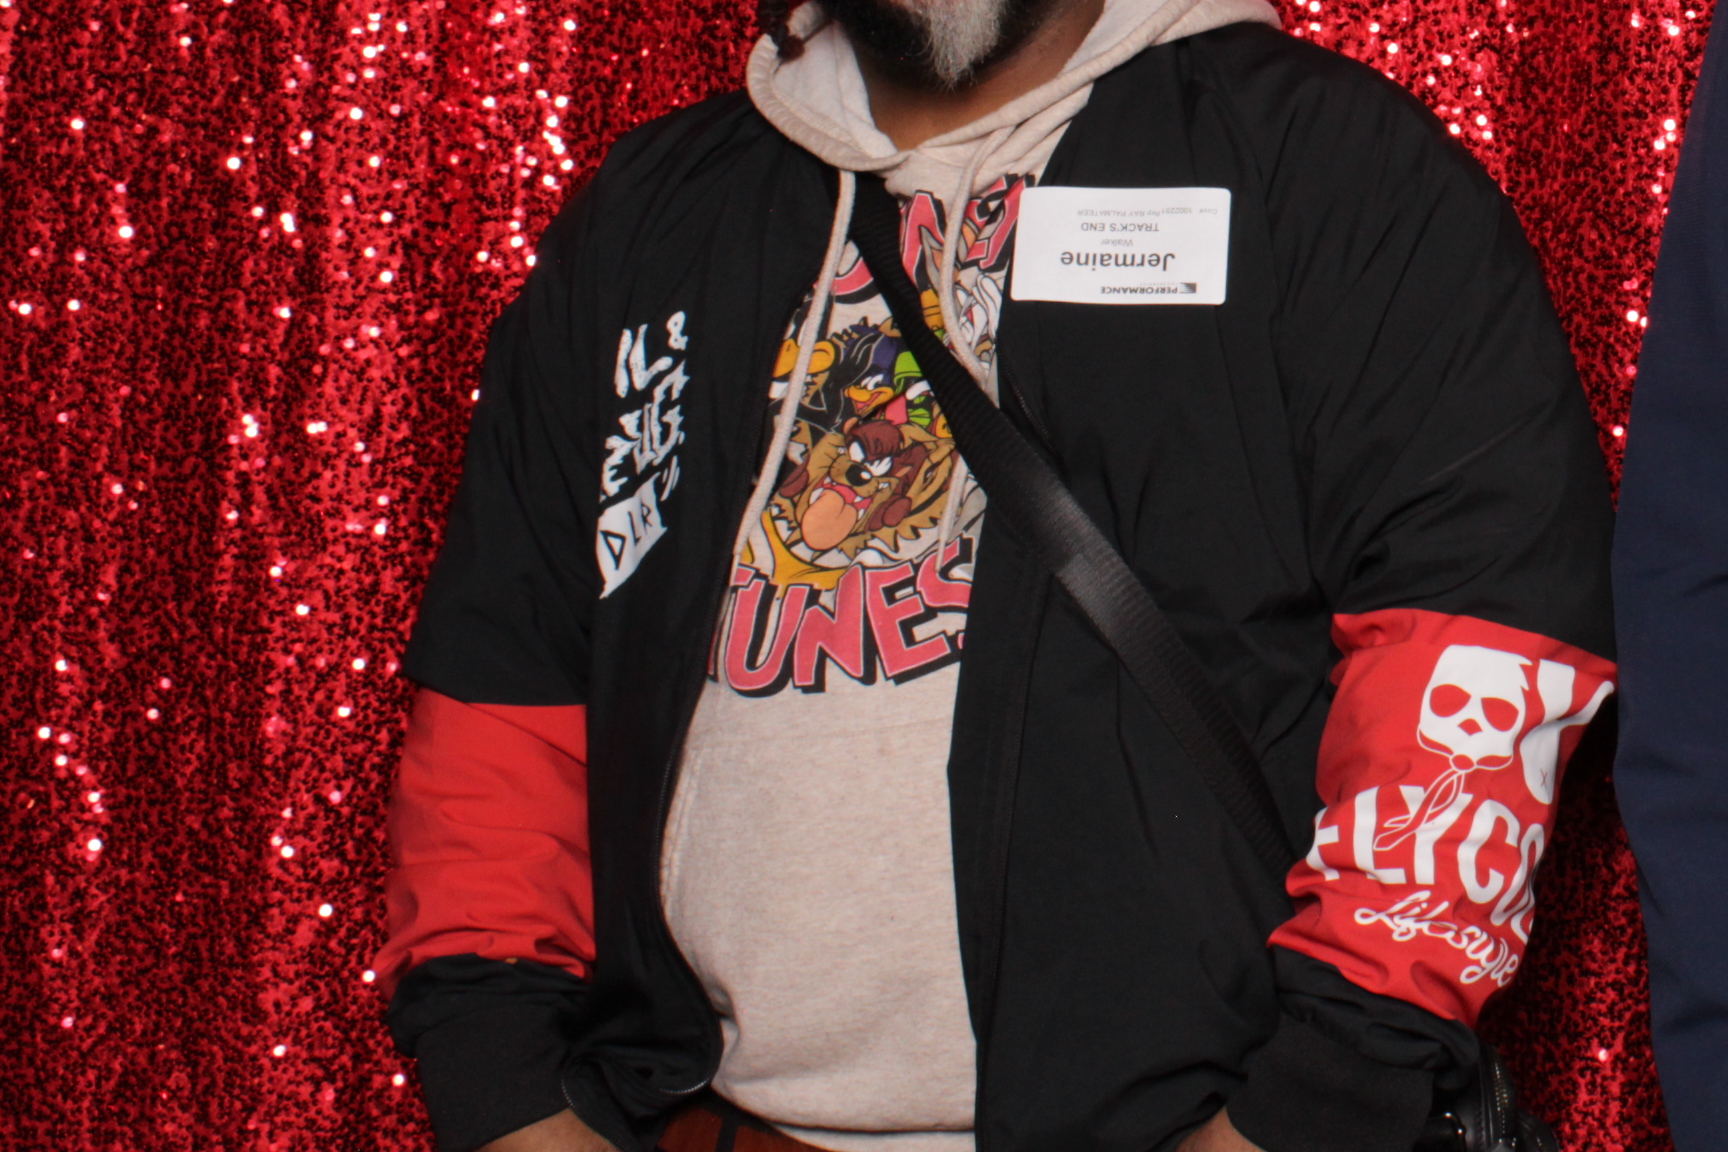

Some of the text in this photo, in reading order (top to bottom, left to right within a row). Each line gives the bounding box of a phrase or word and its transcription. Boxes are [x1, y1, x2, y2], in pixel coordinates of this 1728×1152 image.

[1127, 209, 1146, 217] RAY
[1161, 207, 1192, 215] 1002251
[1080, 222, 1160, 232] TRACK'S END
[1100, 238, 1134, 247] Walker
[1060, 251, 1176, 271] Jermaine
[1100, 286, 1178, 294] PERFORMANCE
